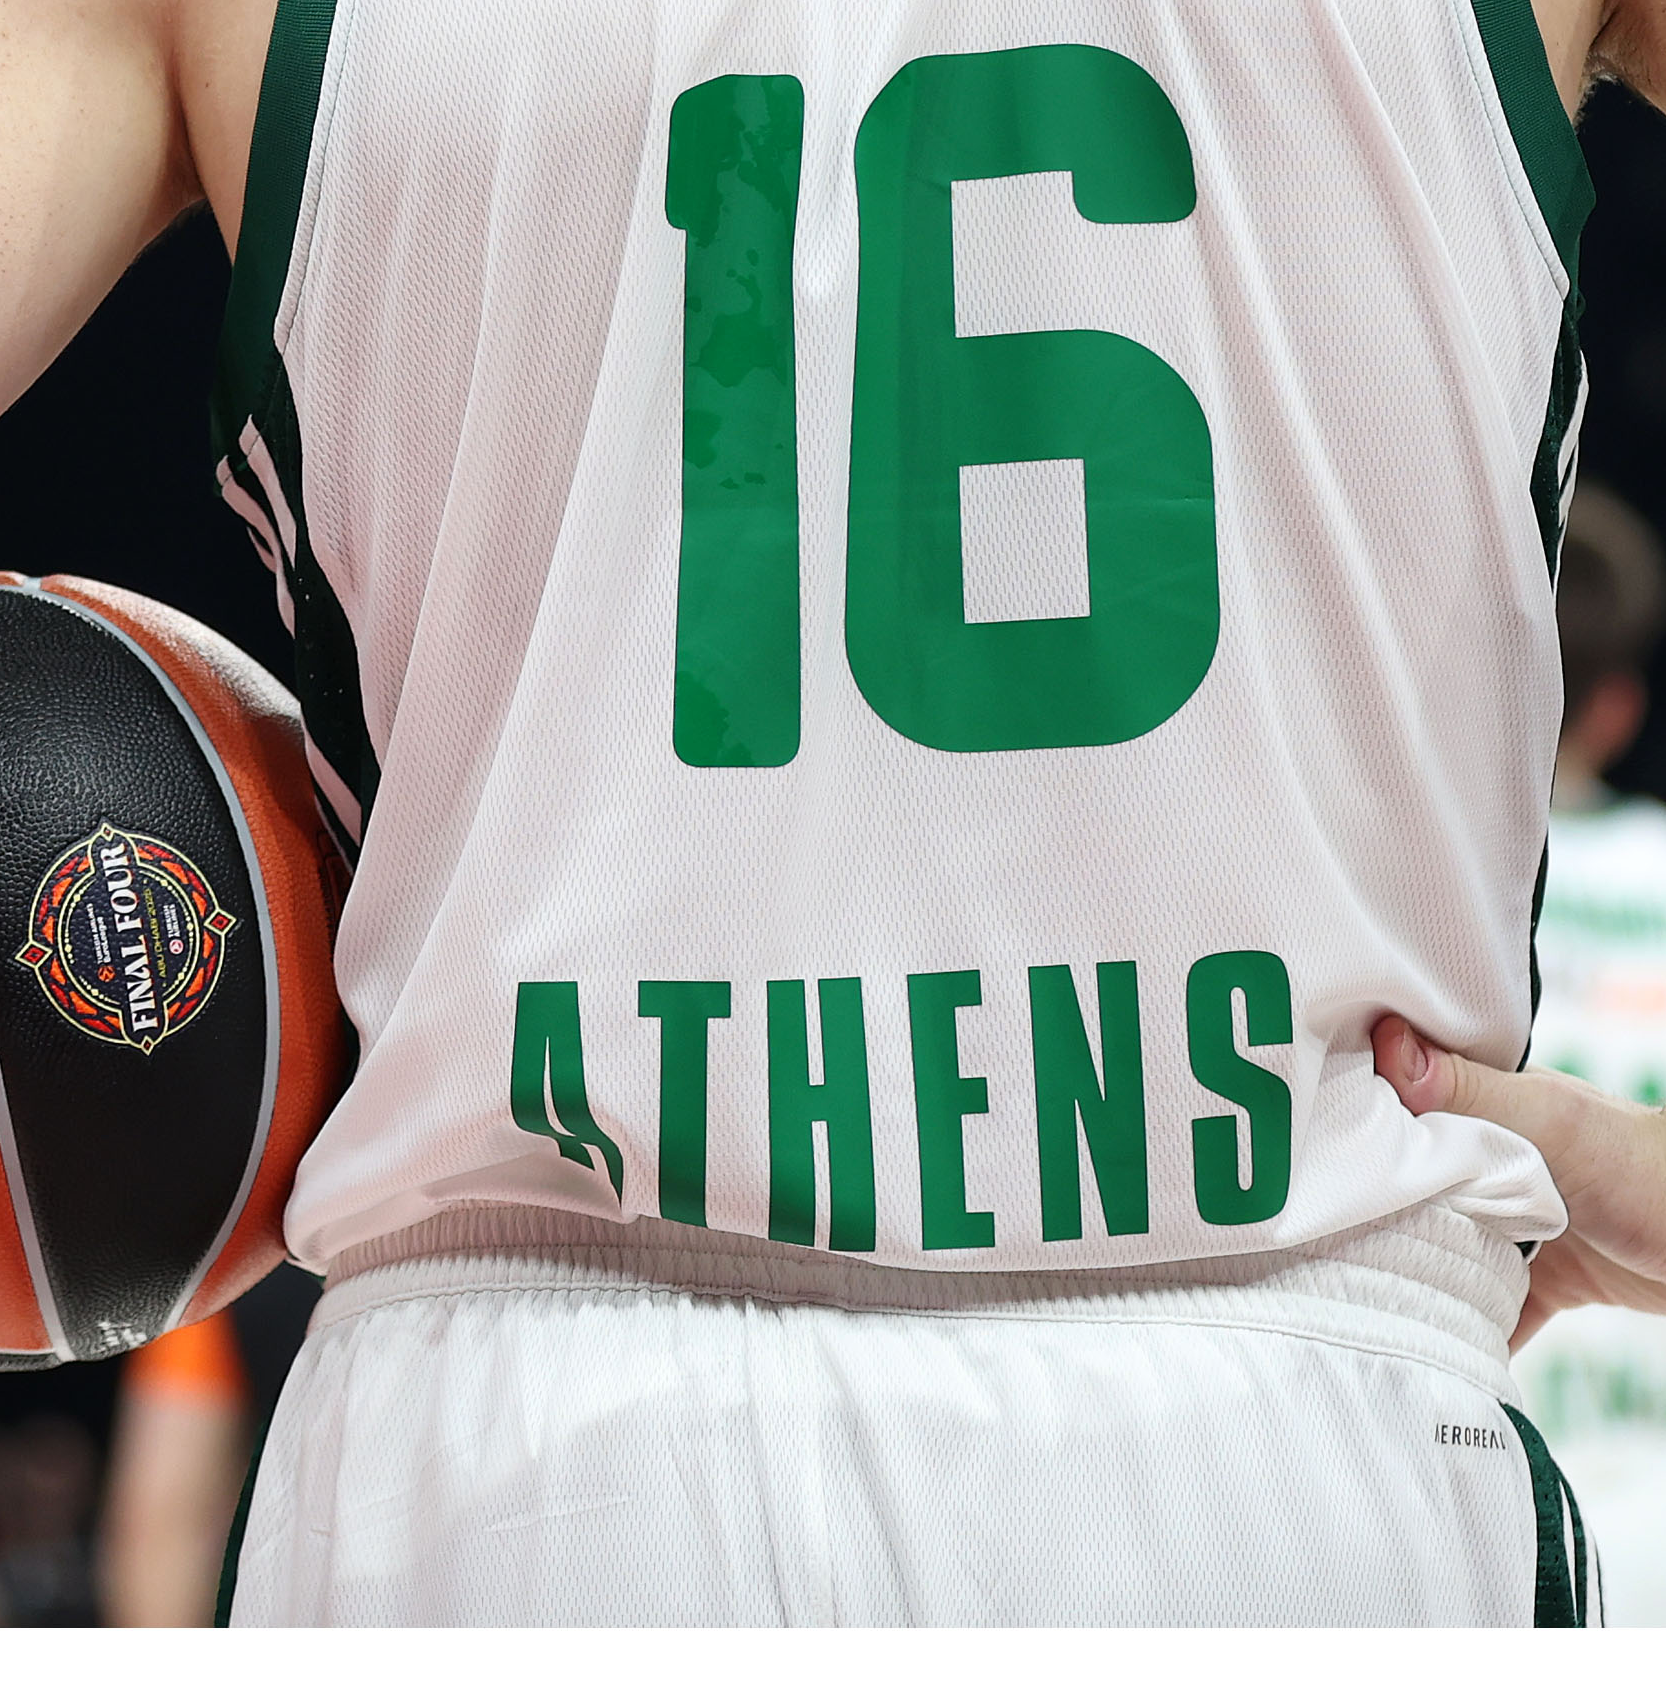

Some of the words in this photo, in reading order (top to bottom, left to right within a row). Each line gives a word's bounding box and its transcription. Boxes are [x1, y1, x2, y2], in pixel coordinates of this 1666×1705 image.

[665, 43, 1221, 768] 16
[100, 843, 145, 933] FOUR
[150, 918, 162, 952] DHABI
[163, 904, 173, 938] TURKISH
[169, 903, 180, 938] AIRLINES
[121, 935, 160, 1033] FINAL
[157, 954, 167, 978] ABU
[509, 950, 1294, 1253] ATHENS
